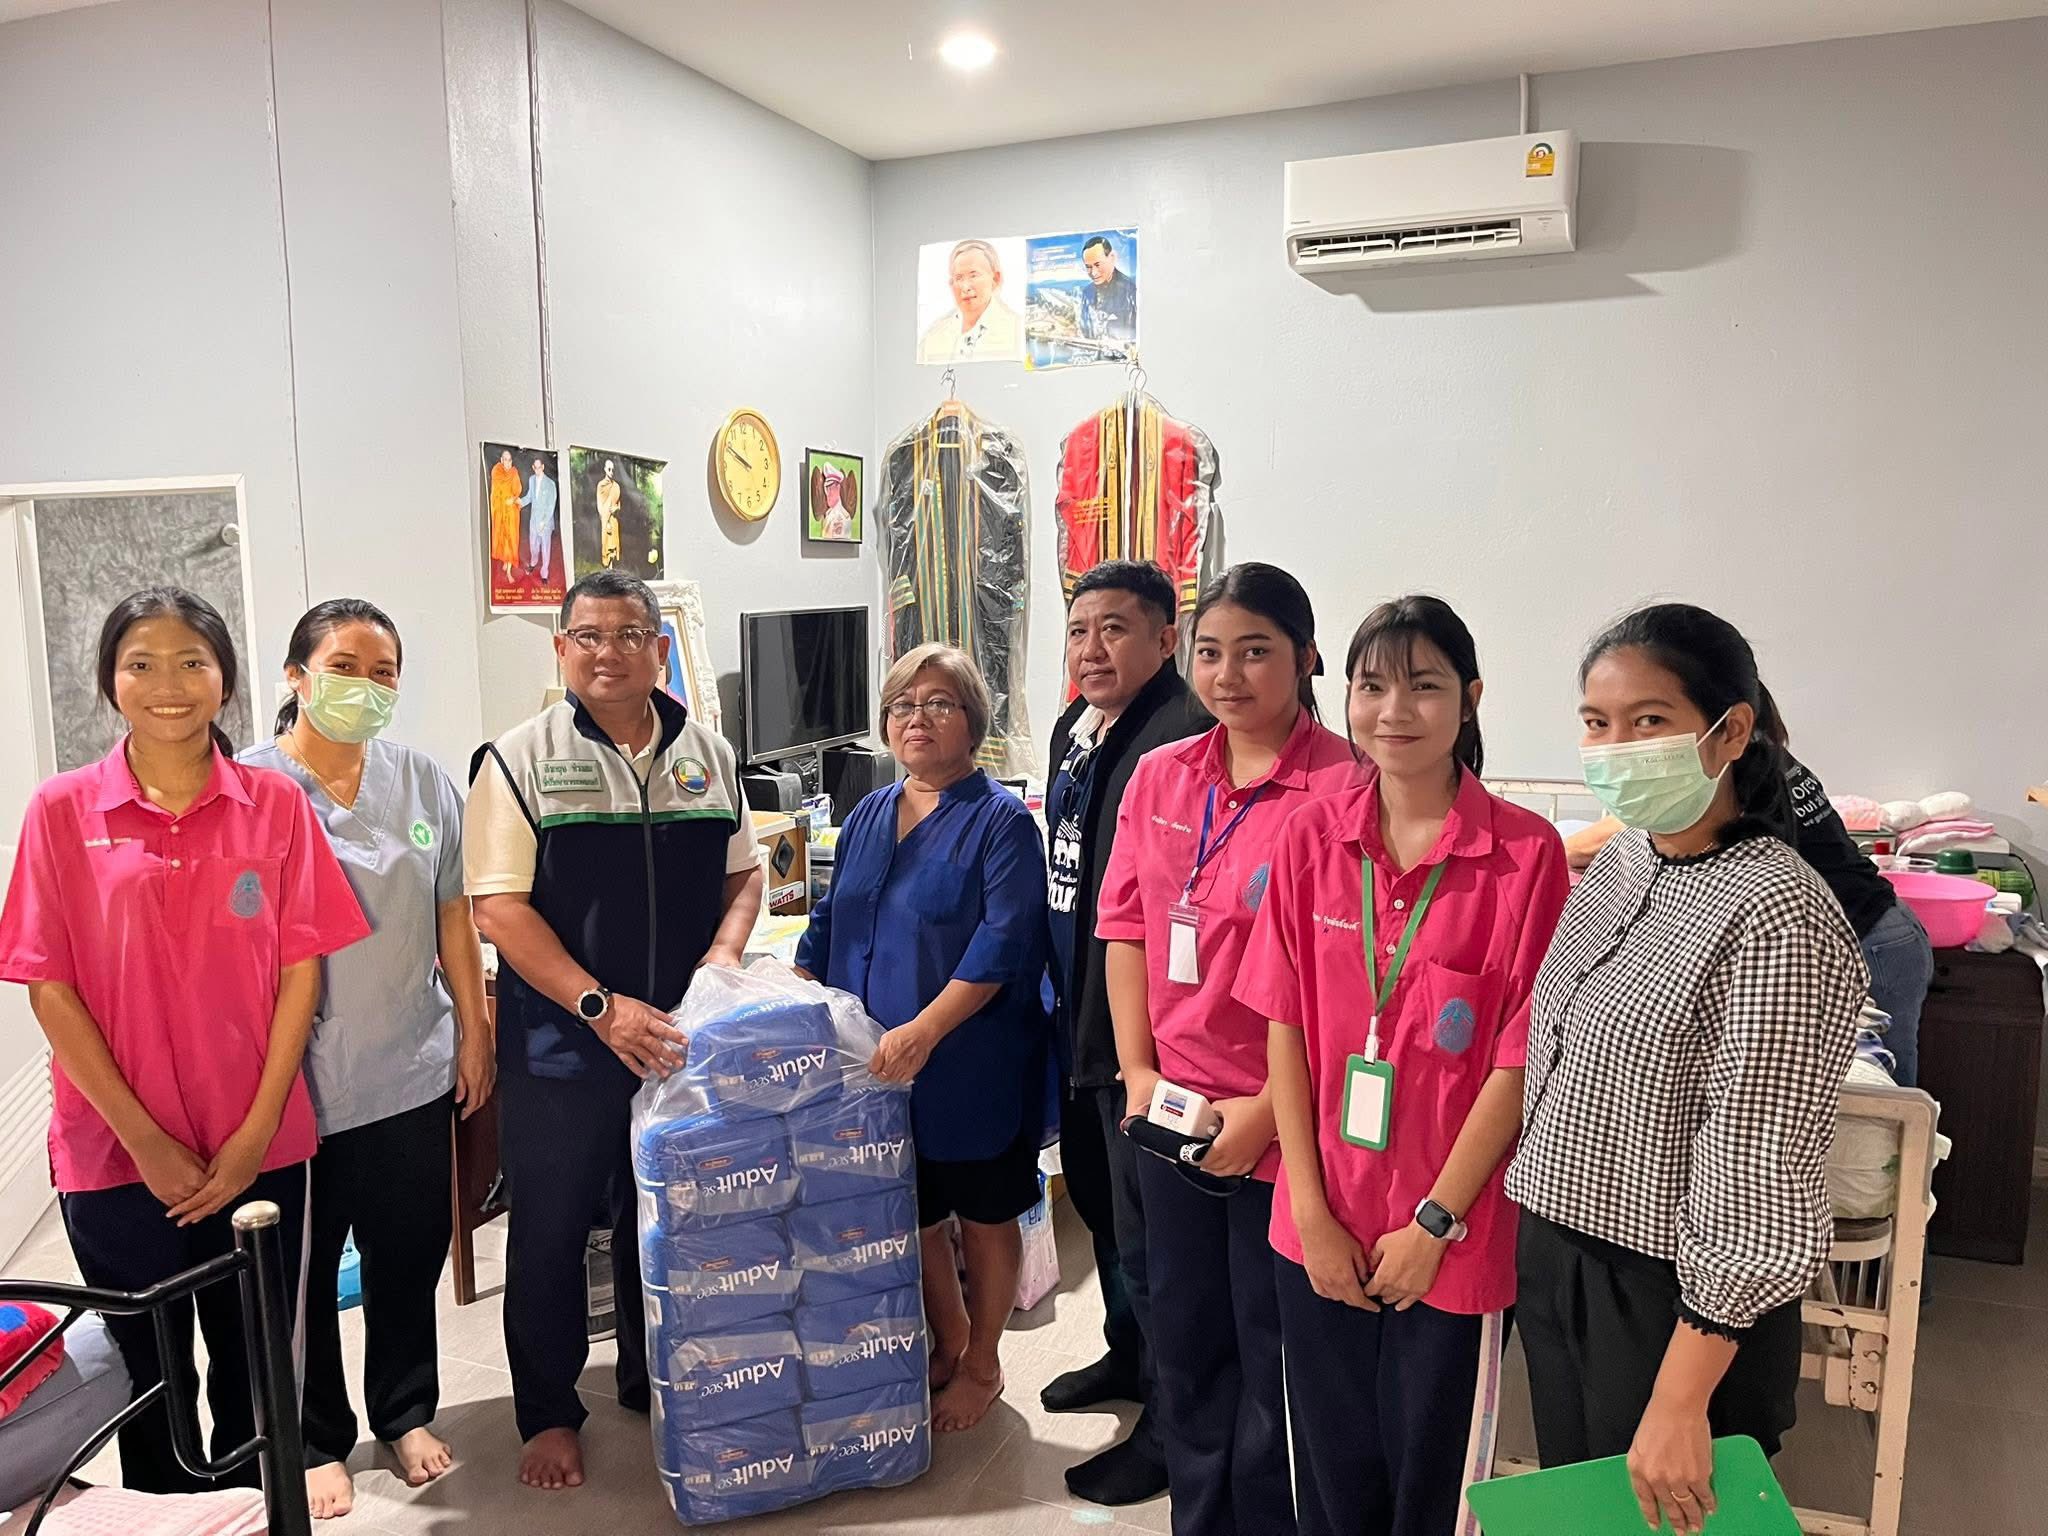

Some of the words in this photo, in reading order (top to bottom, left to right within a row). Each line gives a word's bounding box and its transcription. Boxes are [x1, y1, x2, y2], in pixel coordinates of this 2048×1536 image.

[760, 440, 764, 451] 2
[764, 458, 768, 470] 3
[769, 889, 795, 908] WATTS
[768, 1048, 827, 1083] Adult
[848, 1139, 905, 1165] Adult
[716, 1163, 778, 1194] Adult
[851, 1234, 908, 1263] Adult
[718, 1260, 780, 1292] Adult
[860, 1331, 915, 1359] Adult
[722, 1357, 784, 1390] Adult
[859, 1424, 917, 1452] Adult
[732, 1453, 794, 1485] Adult
